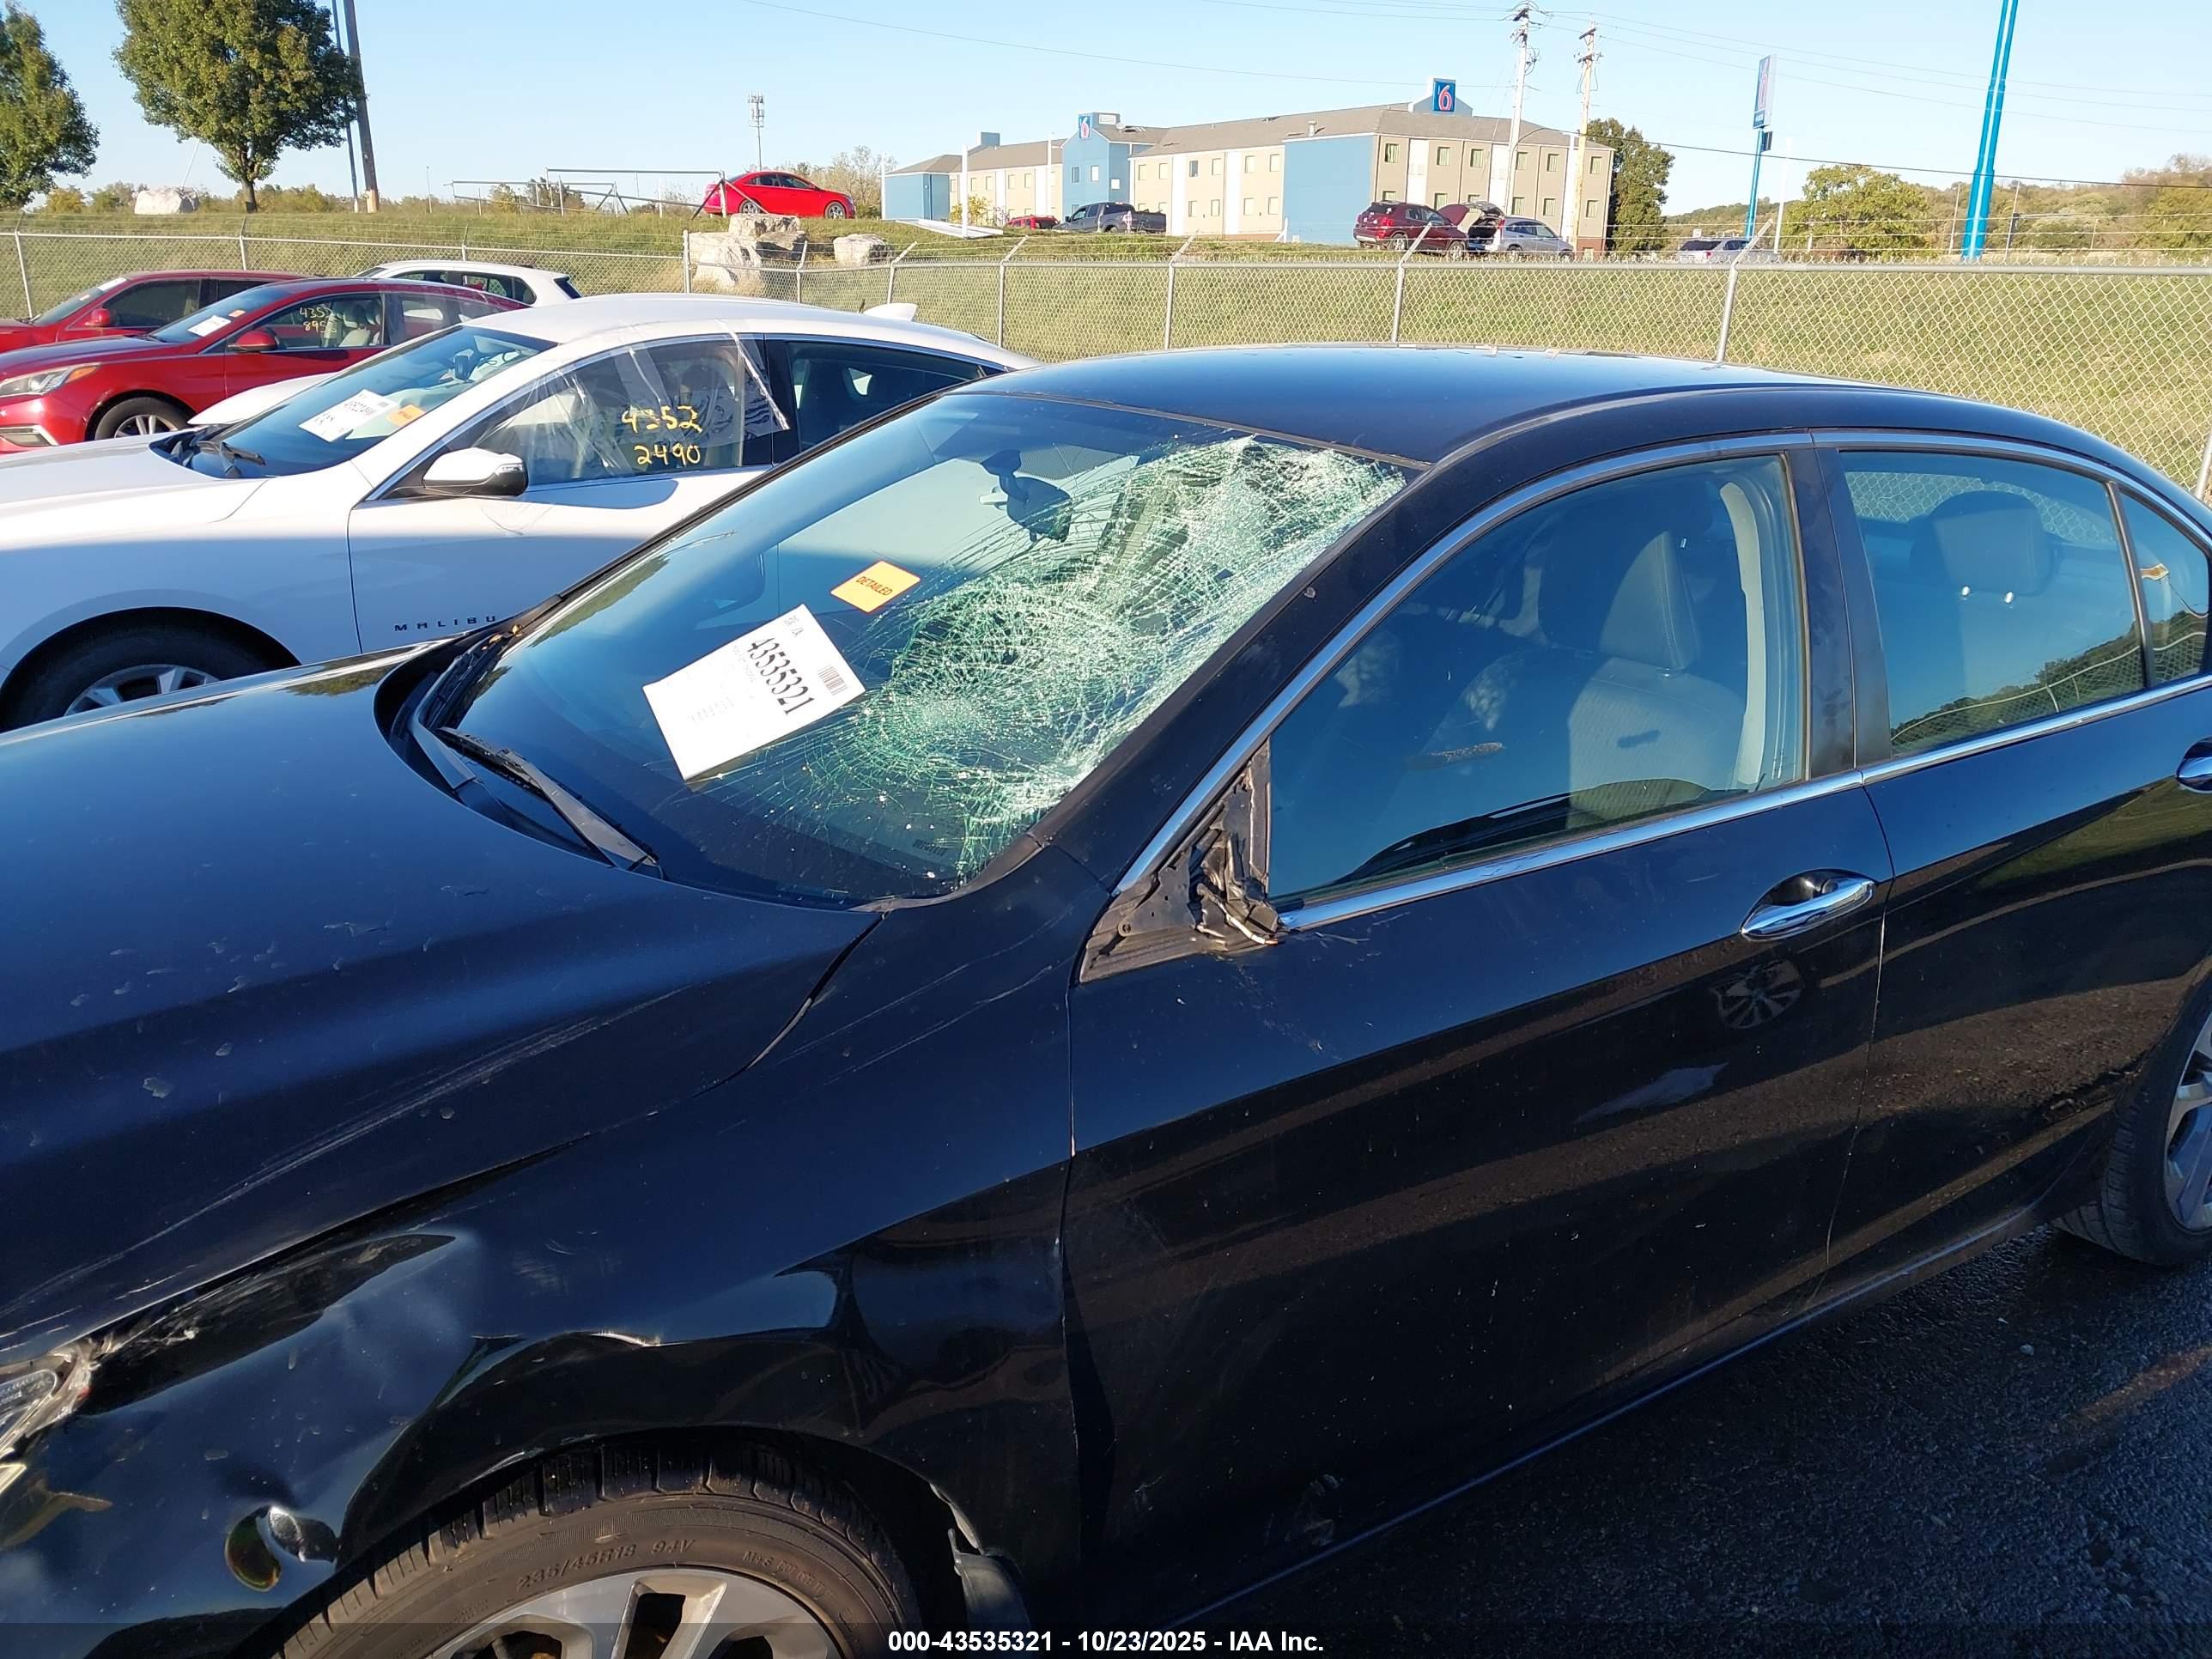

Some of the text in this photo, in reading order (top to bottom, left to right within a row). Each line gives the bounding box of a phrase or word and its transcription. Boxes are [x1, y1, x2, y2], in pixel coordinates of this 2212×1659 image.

[1438, 84, 1452, 111] 6
[621, 404, 702, 433] 4352
[634, 442, 701, 466] 2490
[855, 575, 893, 596] DETAILED
[394, 615, 495, 632] MALIBU
[746, 636, 815, 715] 43535321
